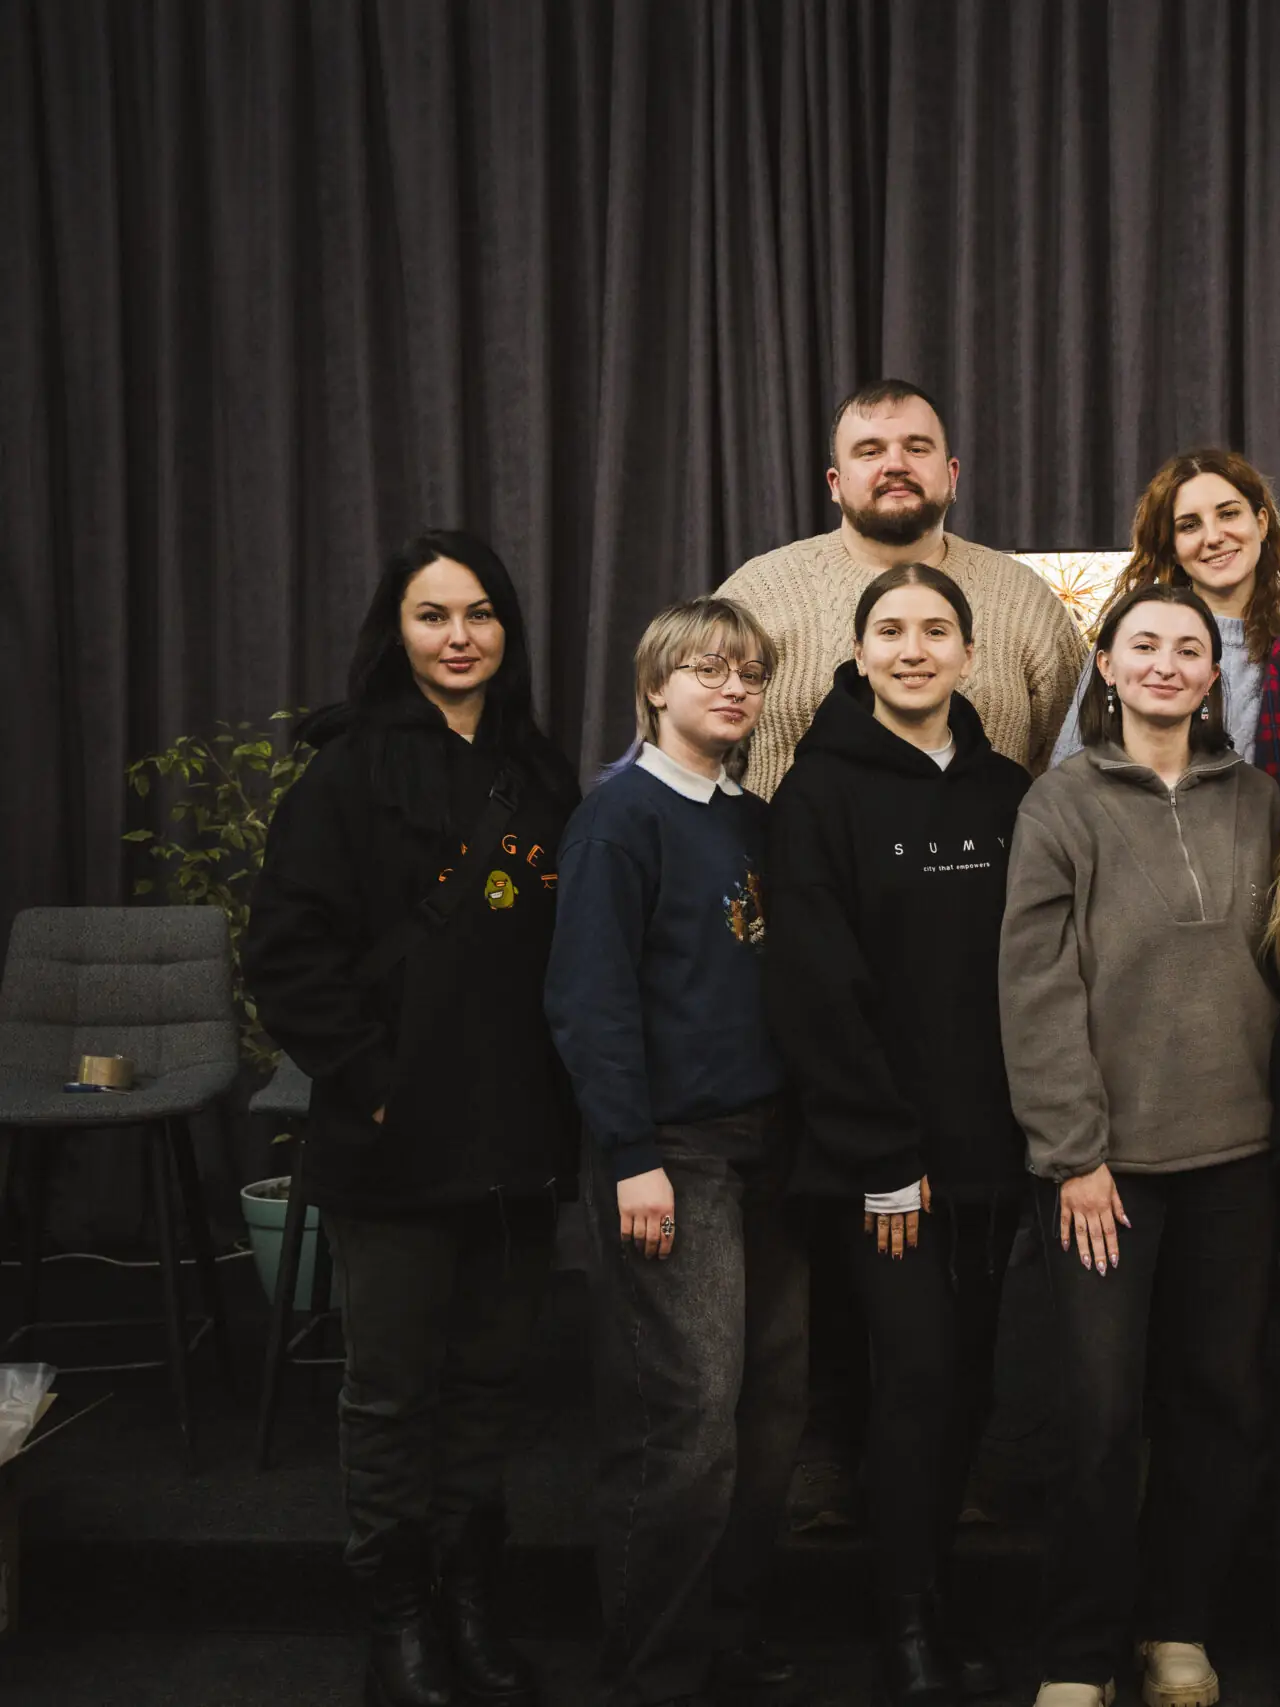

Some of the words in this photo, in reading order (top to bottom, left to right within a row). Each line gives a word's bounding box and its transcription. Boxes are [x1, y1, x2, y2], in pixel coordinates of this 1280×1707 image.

[894, 837, 1005, 855] SUMY
[923, 865, 936, 873] city
[938, 863, 954, 872] that
[956, 861, 991, 871] empowers
